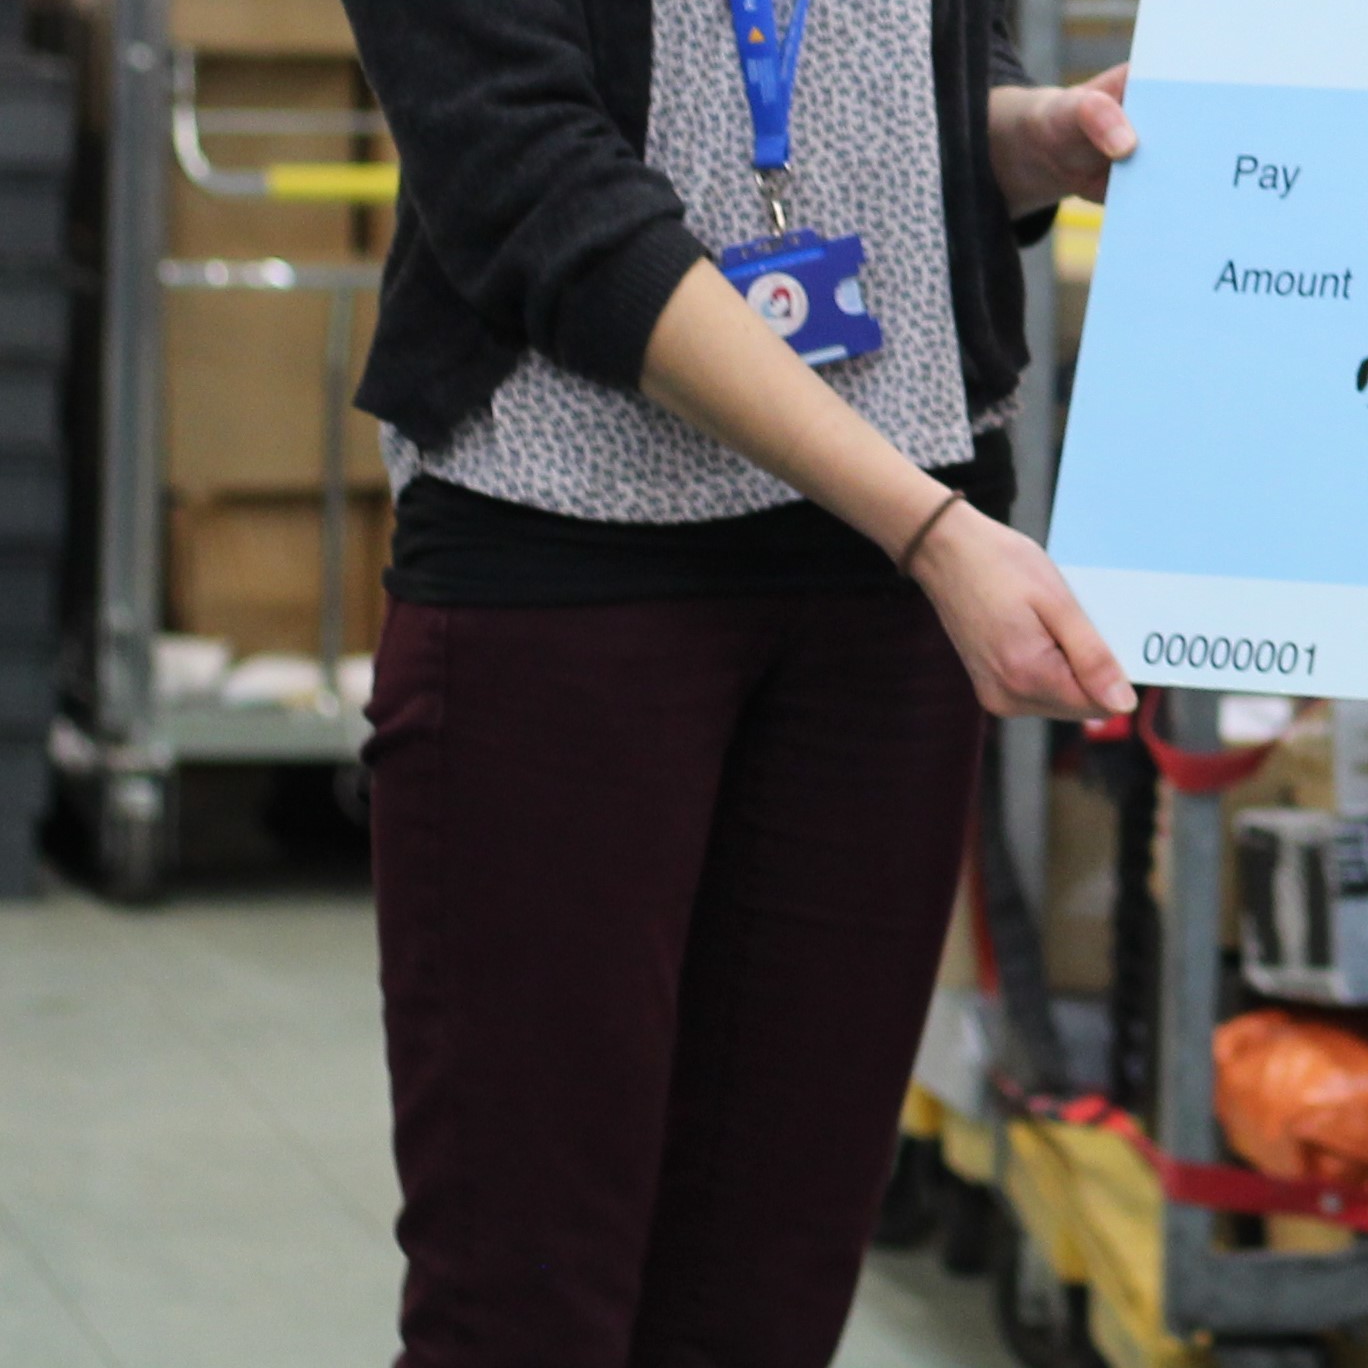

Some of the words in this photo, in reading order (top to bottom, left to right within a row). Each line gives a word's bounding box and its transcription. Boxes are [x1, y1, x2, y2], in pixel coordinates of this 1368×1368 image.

[1233, 154, 1301, 200] Pay
[1213, 259, 1353, 300] Amount
[1141, 630, 1319, 677] 00000001
